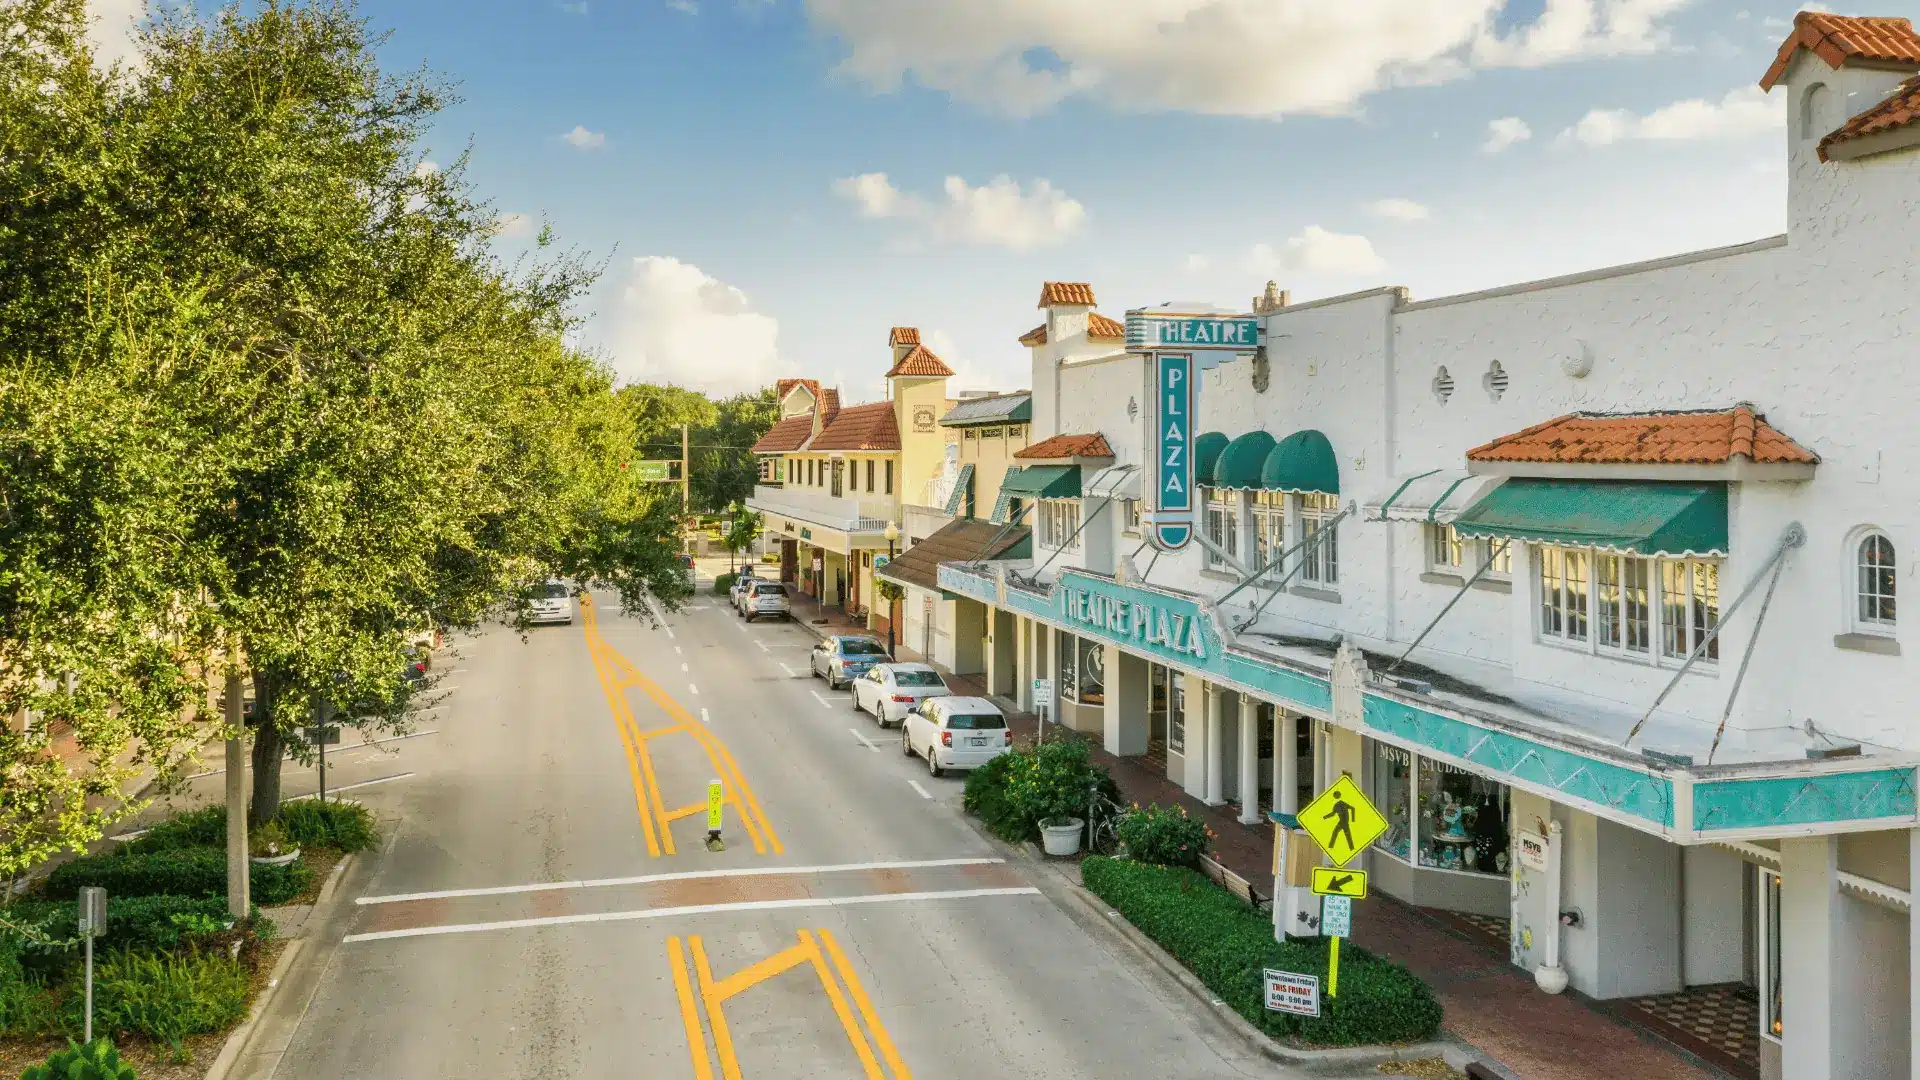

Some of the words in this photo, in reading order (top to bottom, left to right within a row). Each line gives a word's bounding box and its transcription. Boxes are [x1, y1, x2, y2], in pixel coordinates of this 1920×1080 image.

[1152, 320, 1250, 343] THEATRE
[1165, 368, 1184, 493] PLAZA
[1060, 585, 1130, 634] THEATRE
[1131, 602, 1207, 659] PLAZA
[1380, 744, 1410, 767] MSVB
[1523, 838, 1542, 853] MSVB
[1272, 983, 1286, 992] THIS
[1288, 986, 1311, 995] FRIDAY
